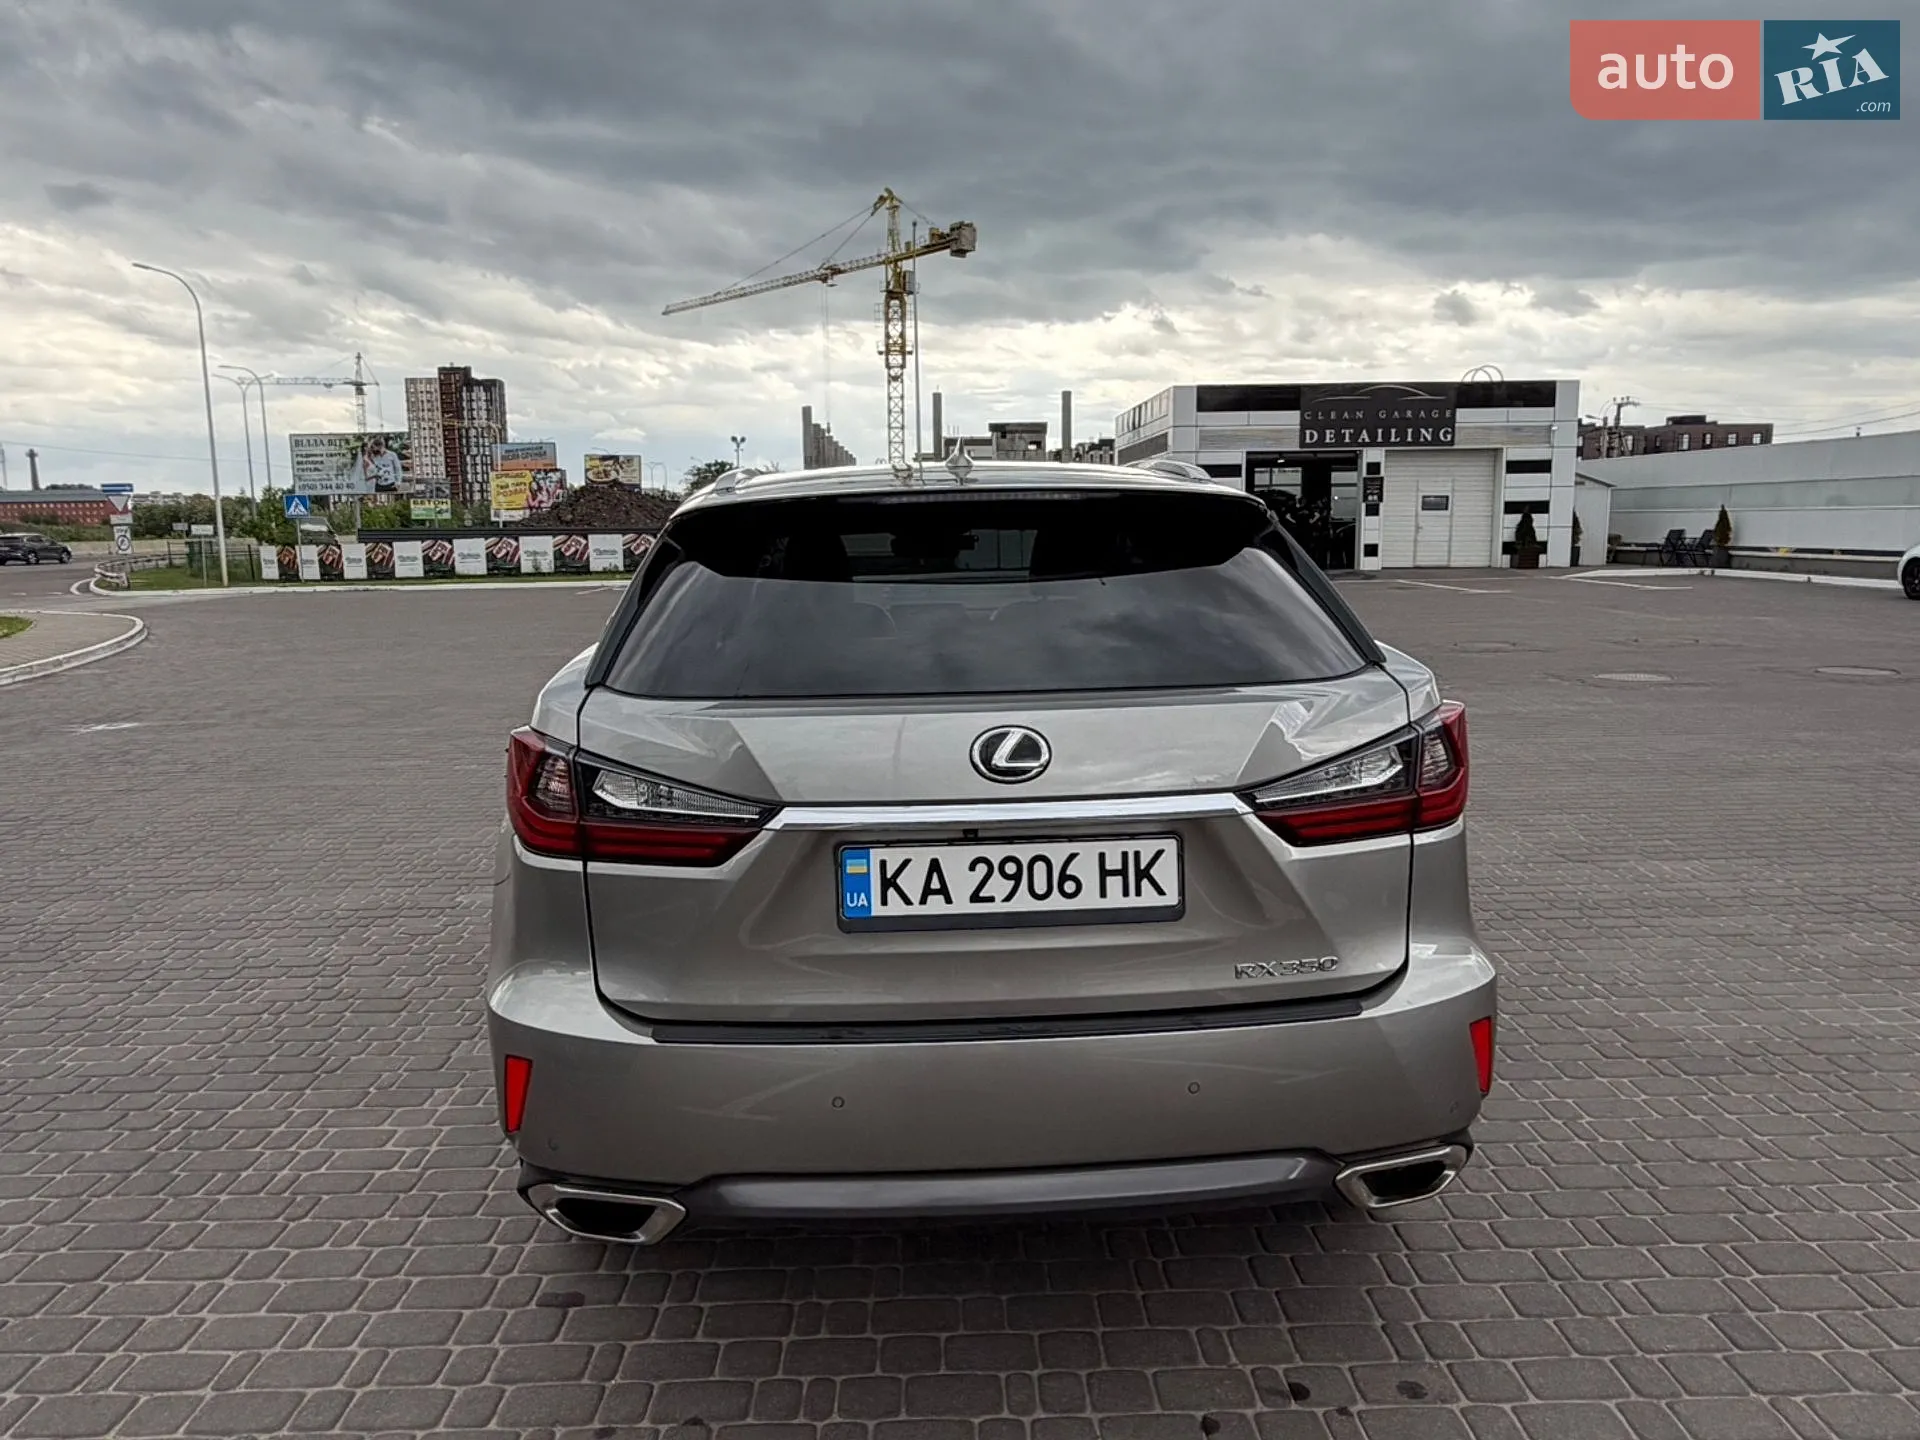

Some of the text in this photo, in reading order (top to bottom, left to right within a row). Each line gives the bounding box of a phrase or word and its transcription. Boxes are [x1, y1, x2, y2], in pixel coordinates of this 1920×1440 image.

[1303, 409, 1453, 421] CLEAN GARAGE
[1304, 427, 1453, 444] DETAILING
[878, 848, 1168, 907] KA 2906 HK
[846, 892, 869, 908] UA
